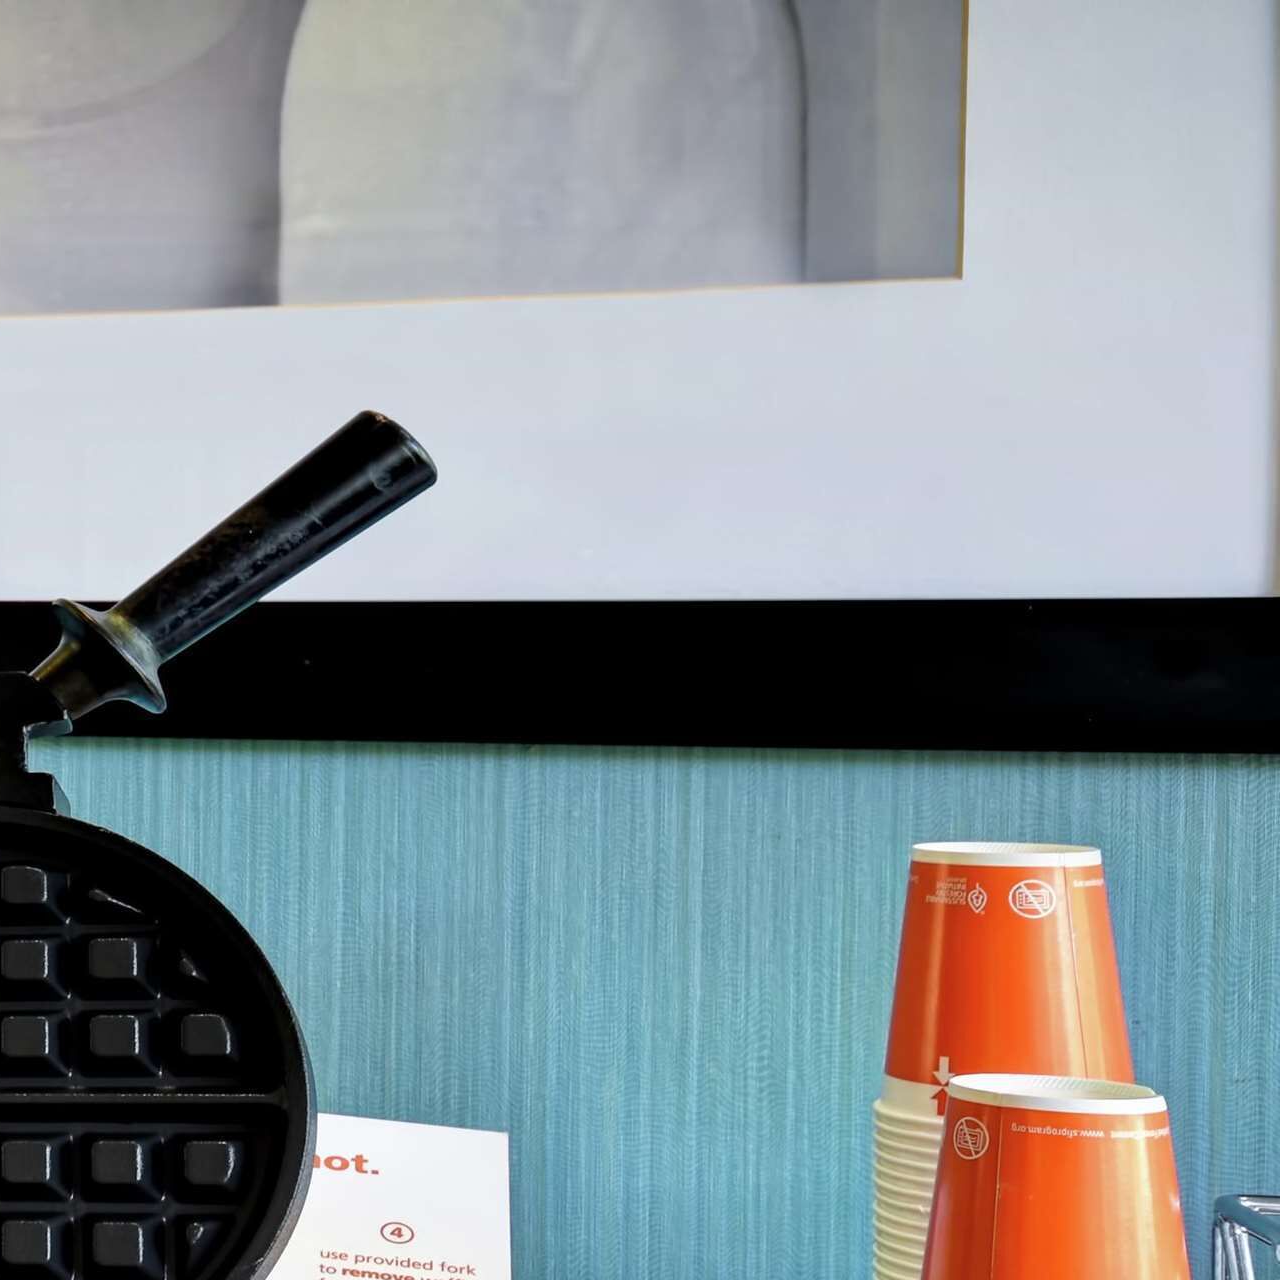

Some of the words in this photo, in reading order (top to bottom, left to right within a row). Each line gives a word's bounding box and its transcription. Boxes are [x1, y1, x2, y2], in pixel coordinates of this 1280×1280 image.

[390, 1227, 403, 1239] 4
[320, 1250, 348, 1262] use
[354, 1252, 433, 1271] provided
[439, 1260, 476, 1276] fork
[320, 1264, 337, 1276] to
